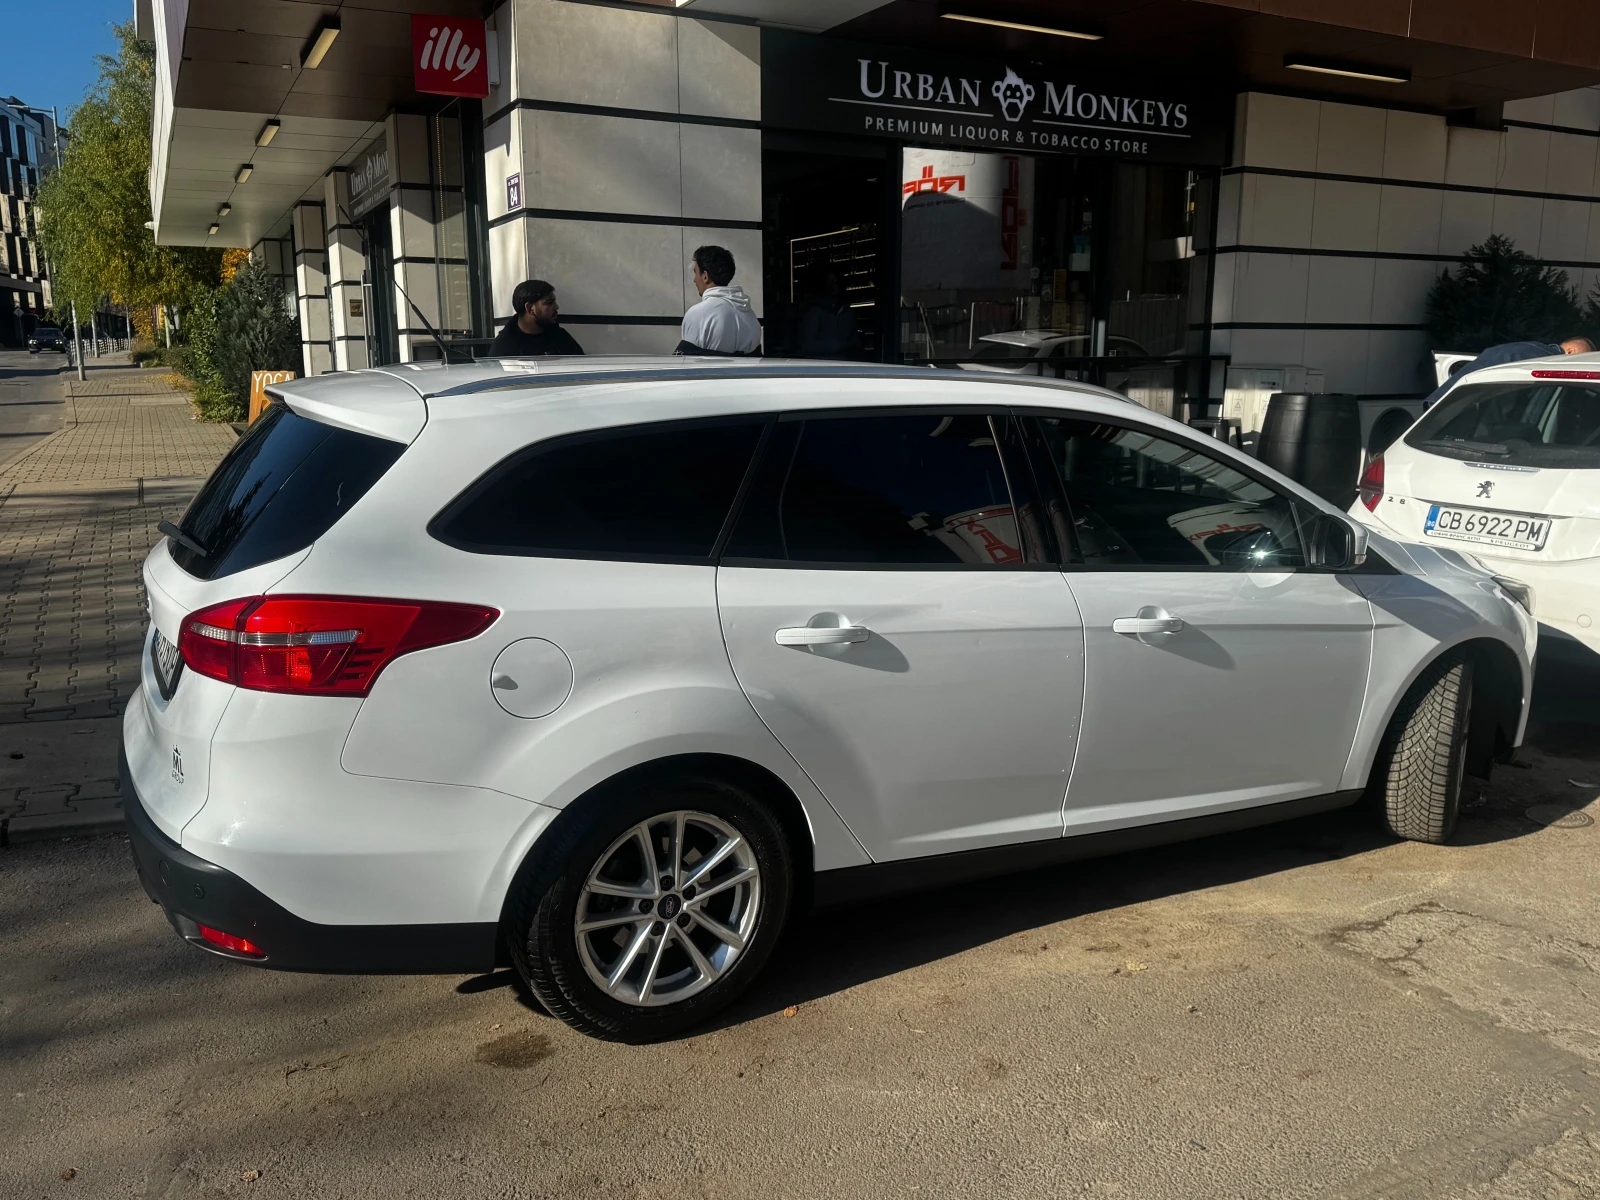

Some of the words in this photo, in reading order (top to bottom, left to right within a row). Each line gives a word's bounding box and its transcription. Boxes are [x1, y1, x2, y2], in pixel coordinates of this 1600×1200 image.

[420, 26, 481, 81] illy
[857, 58, 982, 107] URBAN
[1042, 81, 1188, 129] MONKEYS
[865, 116, 943, 136] PREMIUM
[950, 125, 1009, 142] LIQUOR
[1015, 130, 1025, 143] &
[1030, 132, 1100, 150] TOBACCO
[1104, 138, 1148, 154] STORE
[510, 185, 518, 206] 84
[1438, 511, 1462, 530] CB
[1464, 514, 1513, 537] 6922
[1513, 520, 1544, 542] PM
